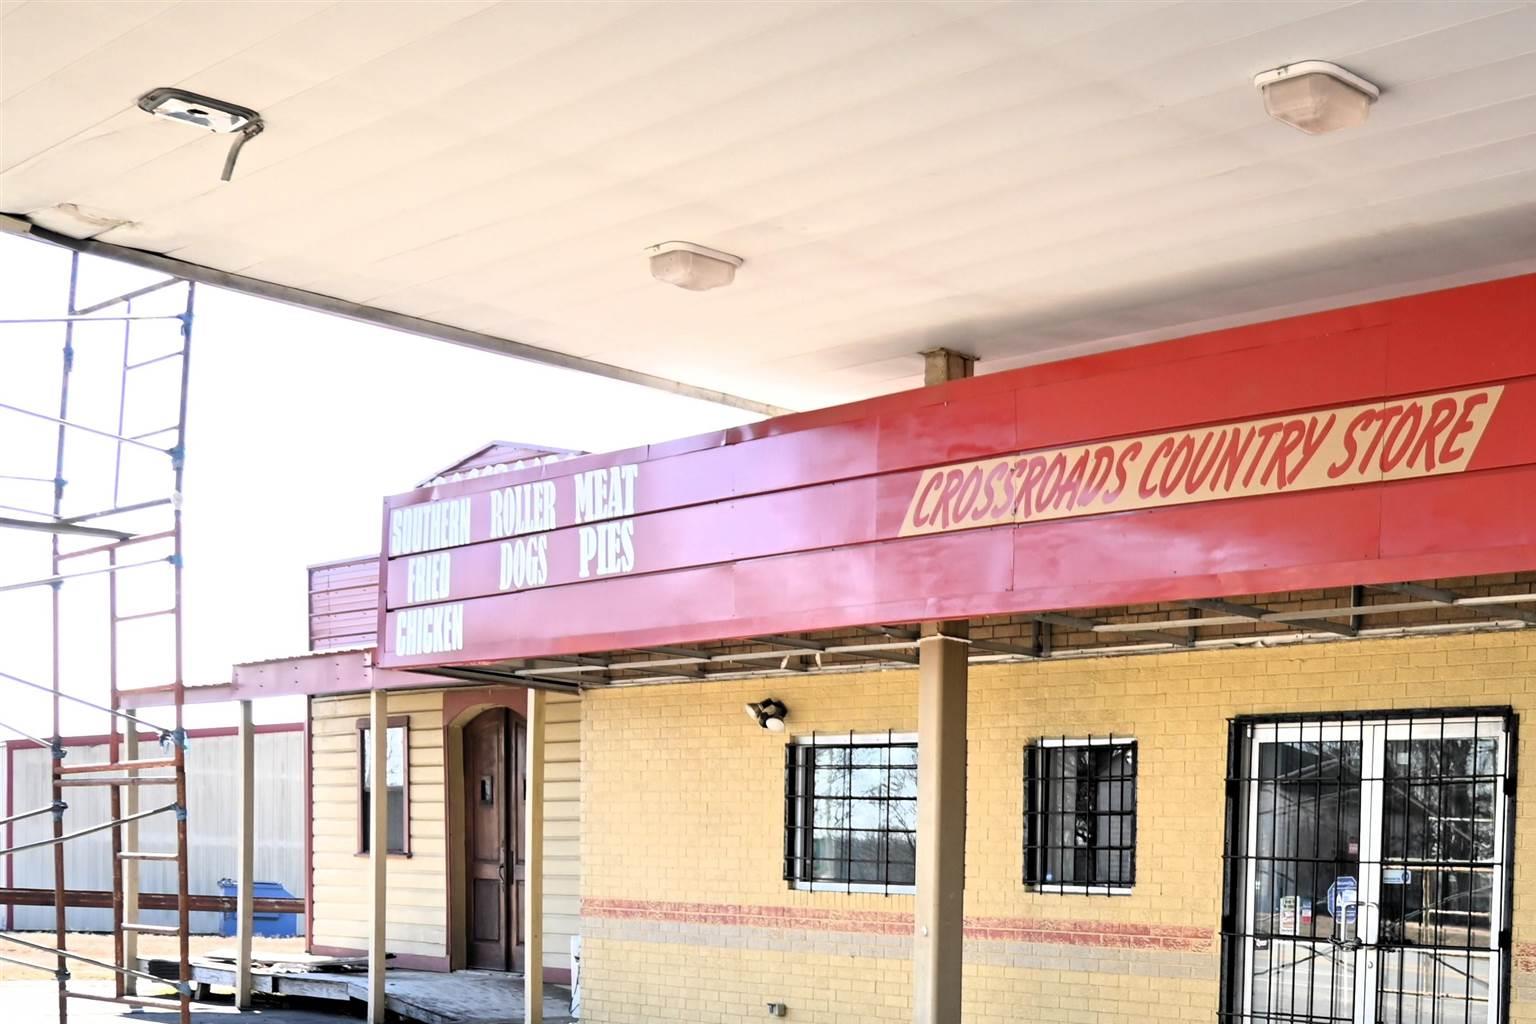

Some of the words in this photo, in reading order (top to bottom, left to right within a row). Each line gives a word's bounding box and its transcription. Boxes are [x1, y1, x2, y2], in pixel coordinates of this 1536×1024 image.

[913, 441, 1142, 529] CROSSROADS
[1138, 413, 1336, 499] COUNTRY
[1326, 392, 1489, 479] STORE
[490, 480, 556, 539] ROLLER
[574, 464, 638, 524] MEAT
[392, 497, 471, 555] SOUTHERN
[578, 519, 635, 578] PIES
[407, 552, 450, 604] FRIED
[499, 534, 548, 590] DOGS
[396, 603, 463, 656] CHICKEN
